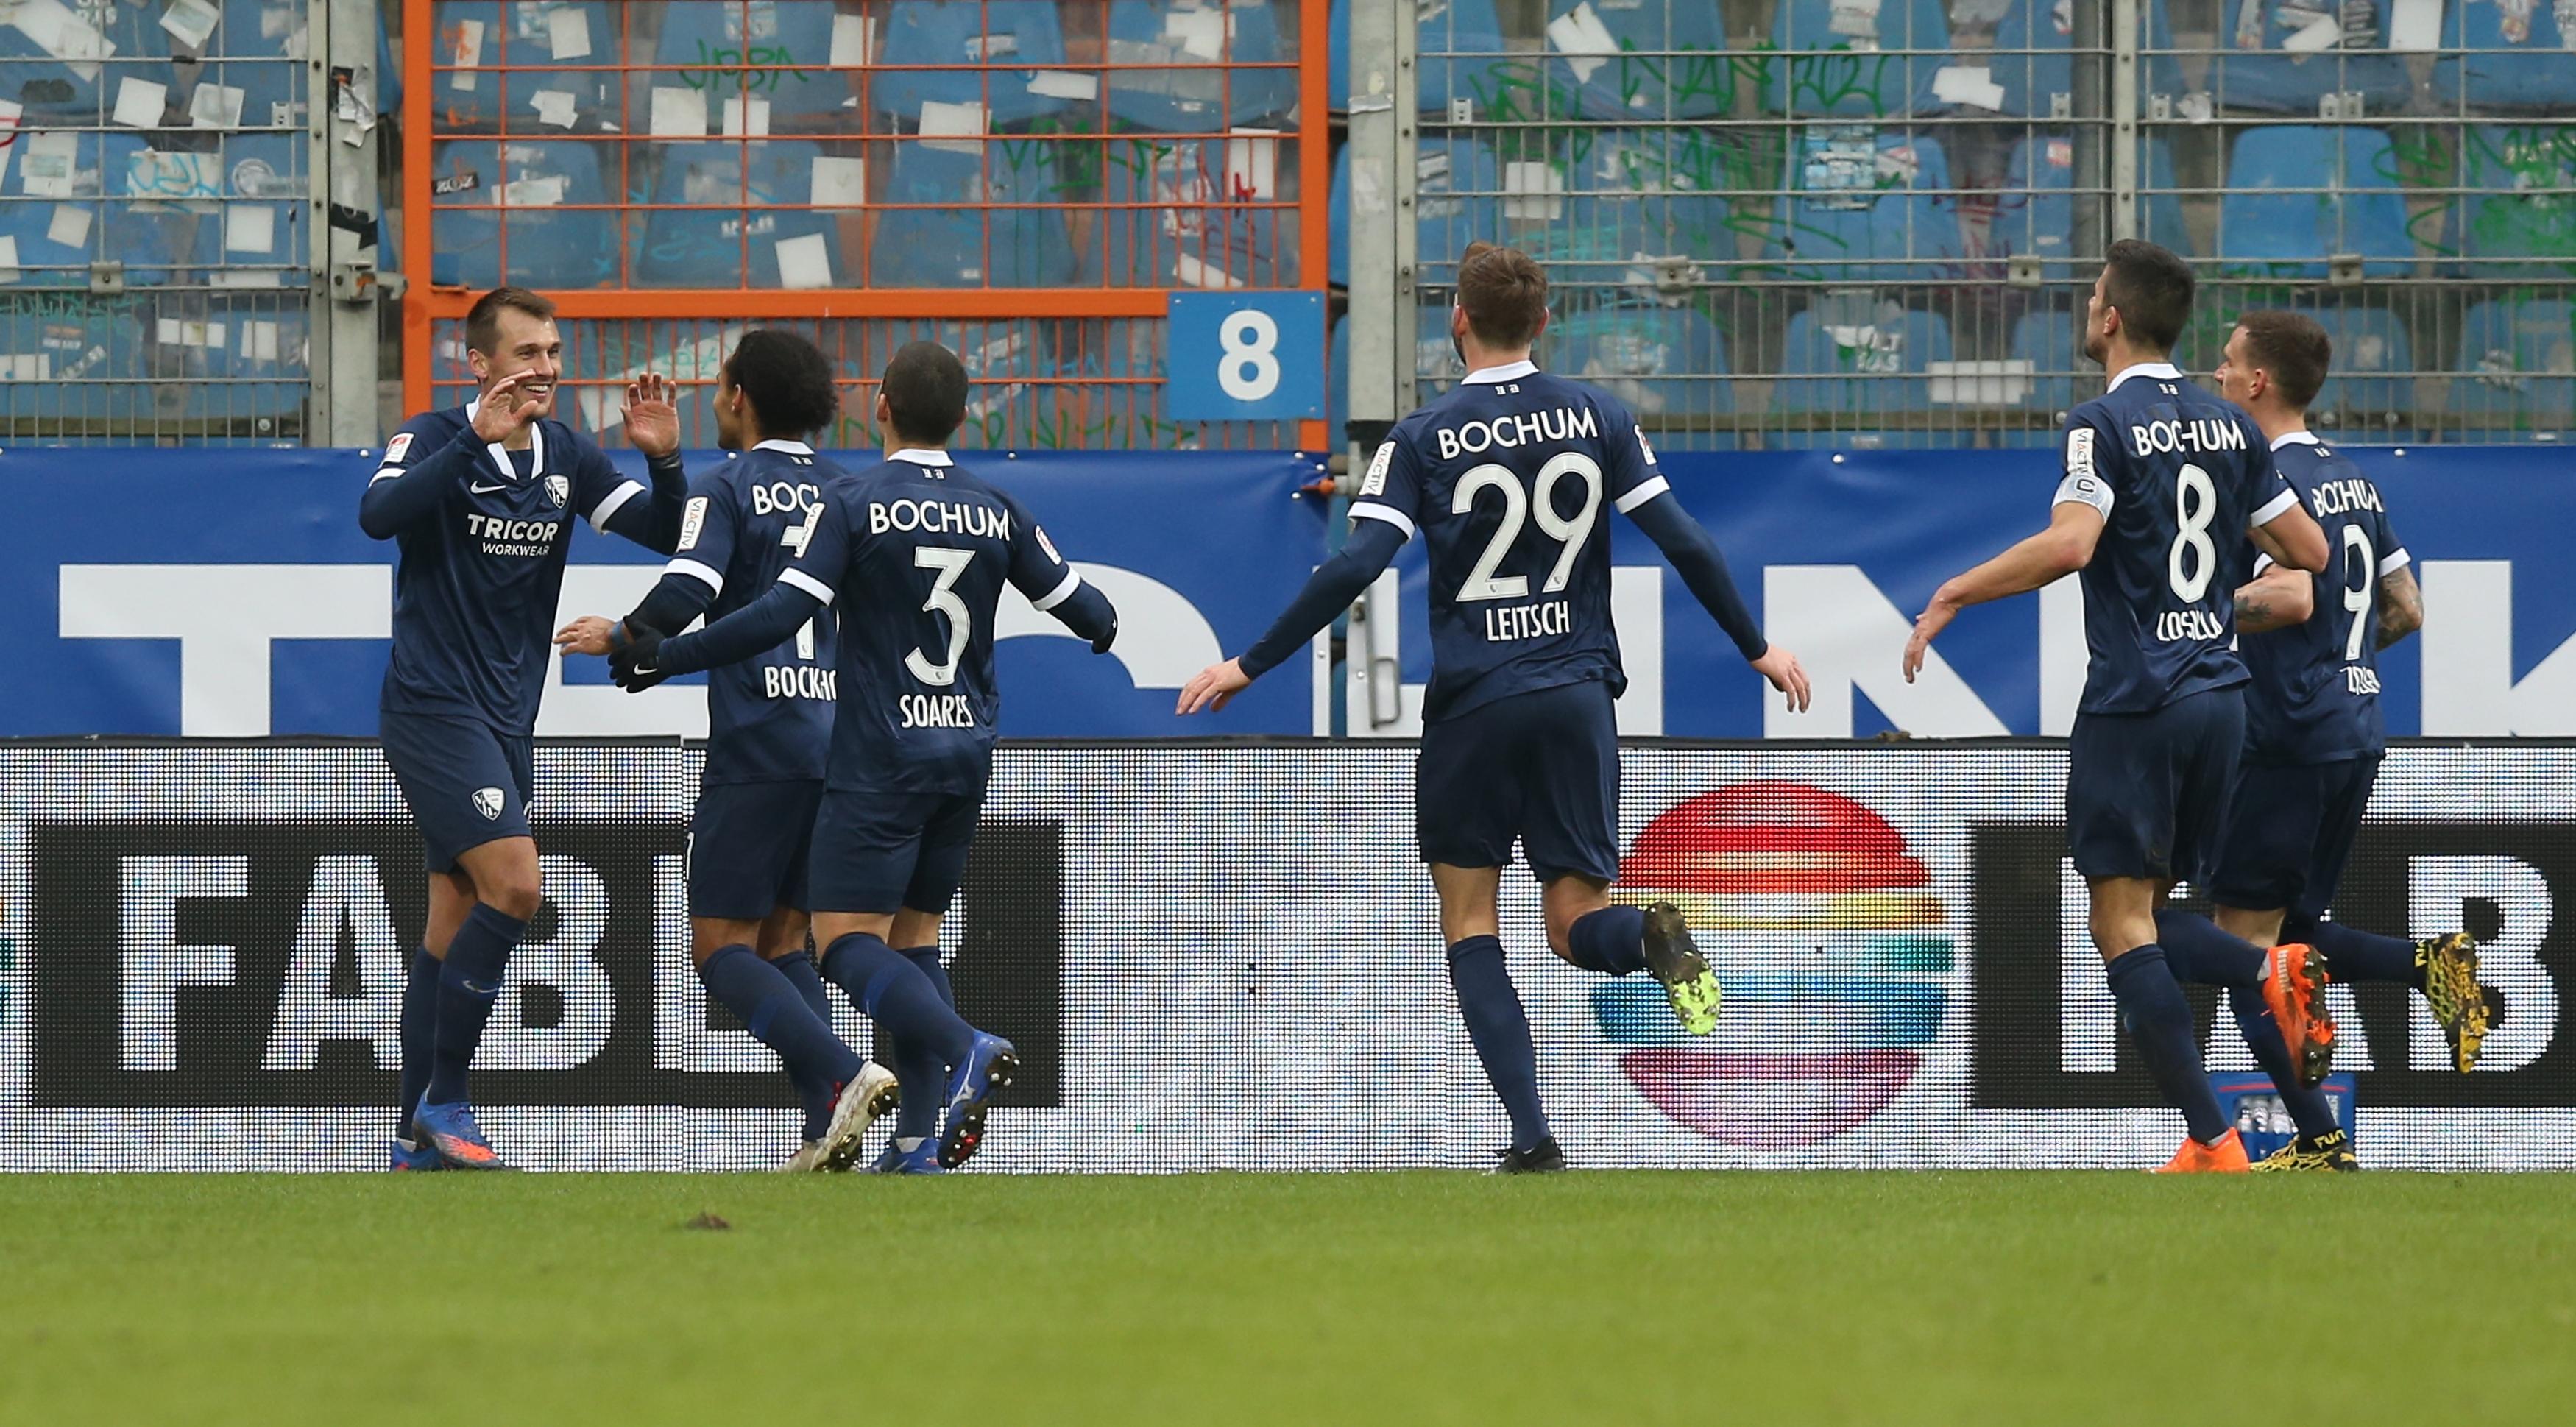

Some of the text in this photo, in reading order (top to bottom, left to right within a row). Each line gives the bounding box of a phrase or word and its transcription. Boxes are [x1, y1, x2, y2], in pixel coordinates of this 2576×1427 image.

[1218, 309, 1280, 402] 8
[1437, 406, 1599, 460] BOCHUM
[752, 481, 820, 515] BOC
[869, 499, 1011, 541] BOCHUM
[467, 513, 559, 542] TRICOR
[682, 499, 703, 547] VIACTIV
[1451, 451, 1603, 602] 29
[2169, 463, 2217, 603] 8
[482, 542, 550, 557] WORKWEAR
[905, 546, 976, 686] 3
[2342, 524, 2374, 661] 9
[1485, 601, 1570, 642] LEITSCH
[899, 694, 974, 729] SOARES
